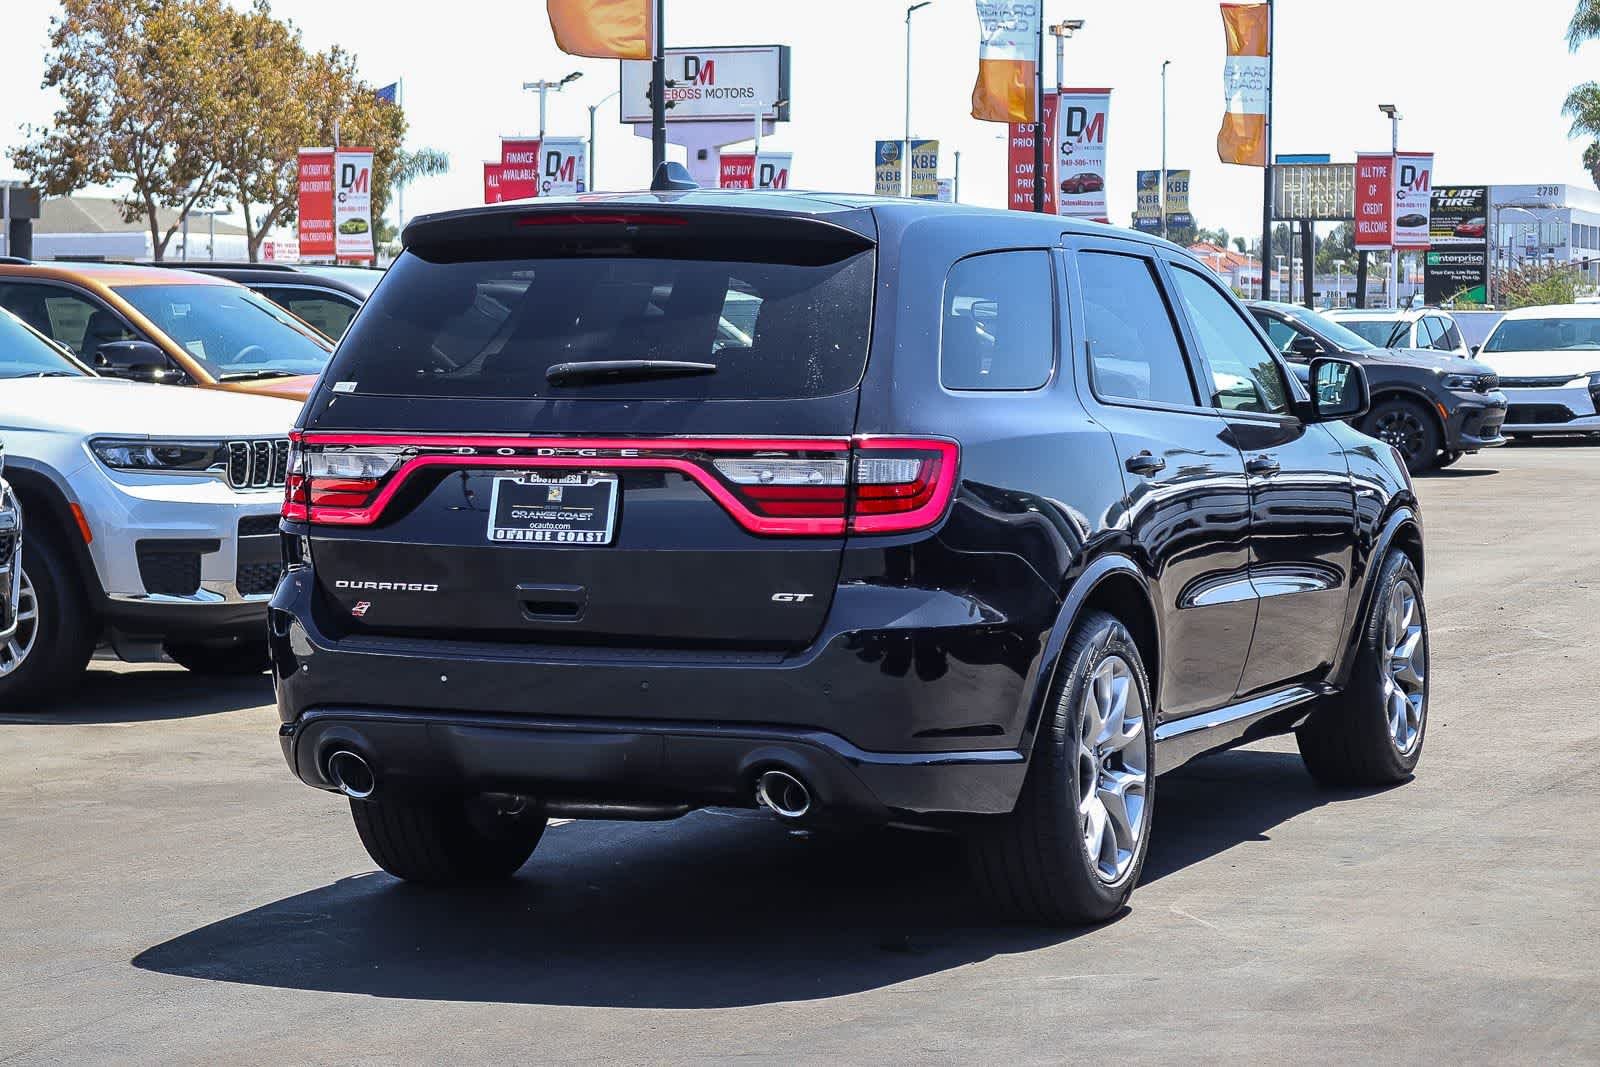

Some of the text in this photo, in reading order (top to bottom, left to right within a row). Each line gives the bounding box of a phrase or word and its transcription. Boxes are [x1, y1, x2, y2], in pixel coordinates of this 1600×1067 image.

[684, 56, 715, 86] DM
[663, 87, 755, 100] EBOSS MOTORS
[1027, 123, 1047, 133] OR
[1066, 106, 1105, 144] DM
[506, 152, 534, 163] FINANCE
[912, 154, 937, 169] KBB
[546, 150, 576, 182] DM
[723, 165, 752, 176] WE BUY
[1015, 164, 1049, 174] LOWT
[1361, 166, 1387, 178] ALL TYPE
[342, 163, 369, 194] DM
[488, 174, 500, 187] ALL
[503, 169, 536, 181] AVAILABLE
[876, 171, 901, 181] KBB
[1401, 165, 1430, 193] DM
[1167, 181, 1189, 193] KBB
[1368, 184, 1377, 197] OF
[1014, 193, 1052, 203] IN TON
[1437, 198, 1476, 207] TIRE
[1362, 203, 1384, 215] CREDIT
[1359, 221, 1388, 233] WELCOME
[1431, 254, 1483, 263] enterprise
[457, 446, 640, 458] DODGE
[511, 510, 593, 521] ORANGE COAST
[529, 521, 571, 530] ocauto.com
[496, 529, 604, 542] ORANGE COAST
[335, 580, 439, 592] DURANGO
[771, 592, 814, 602] GT
